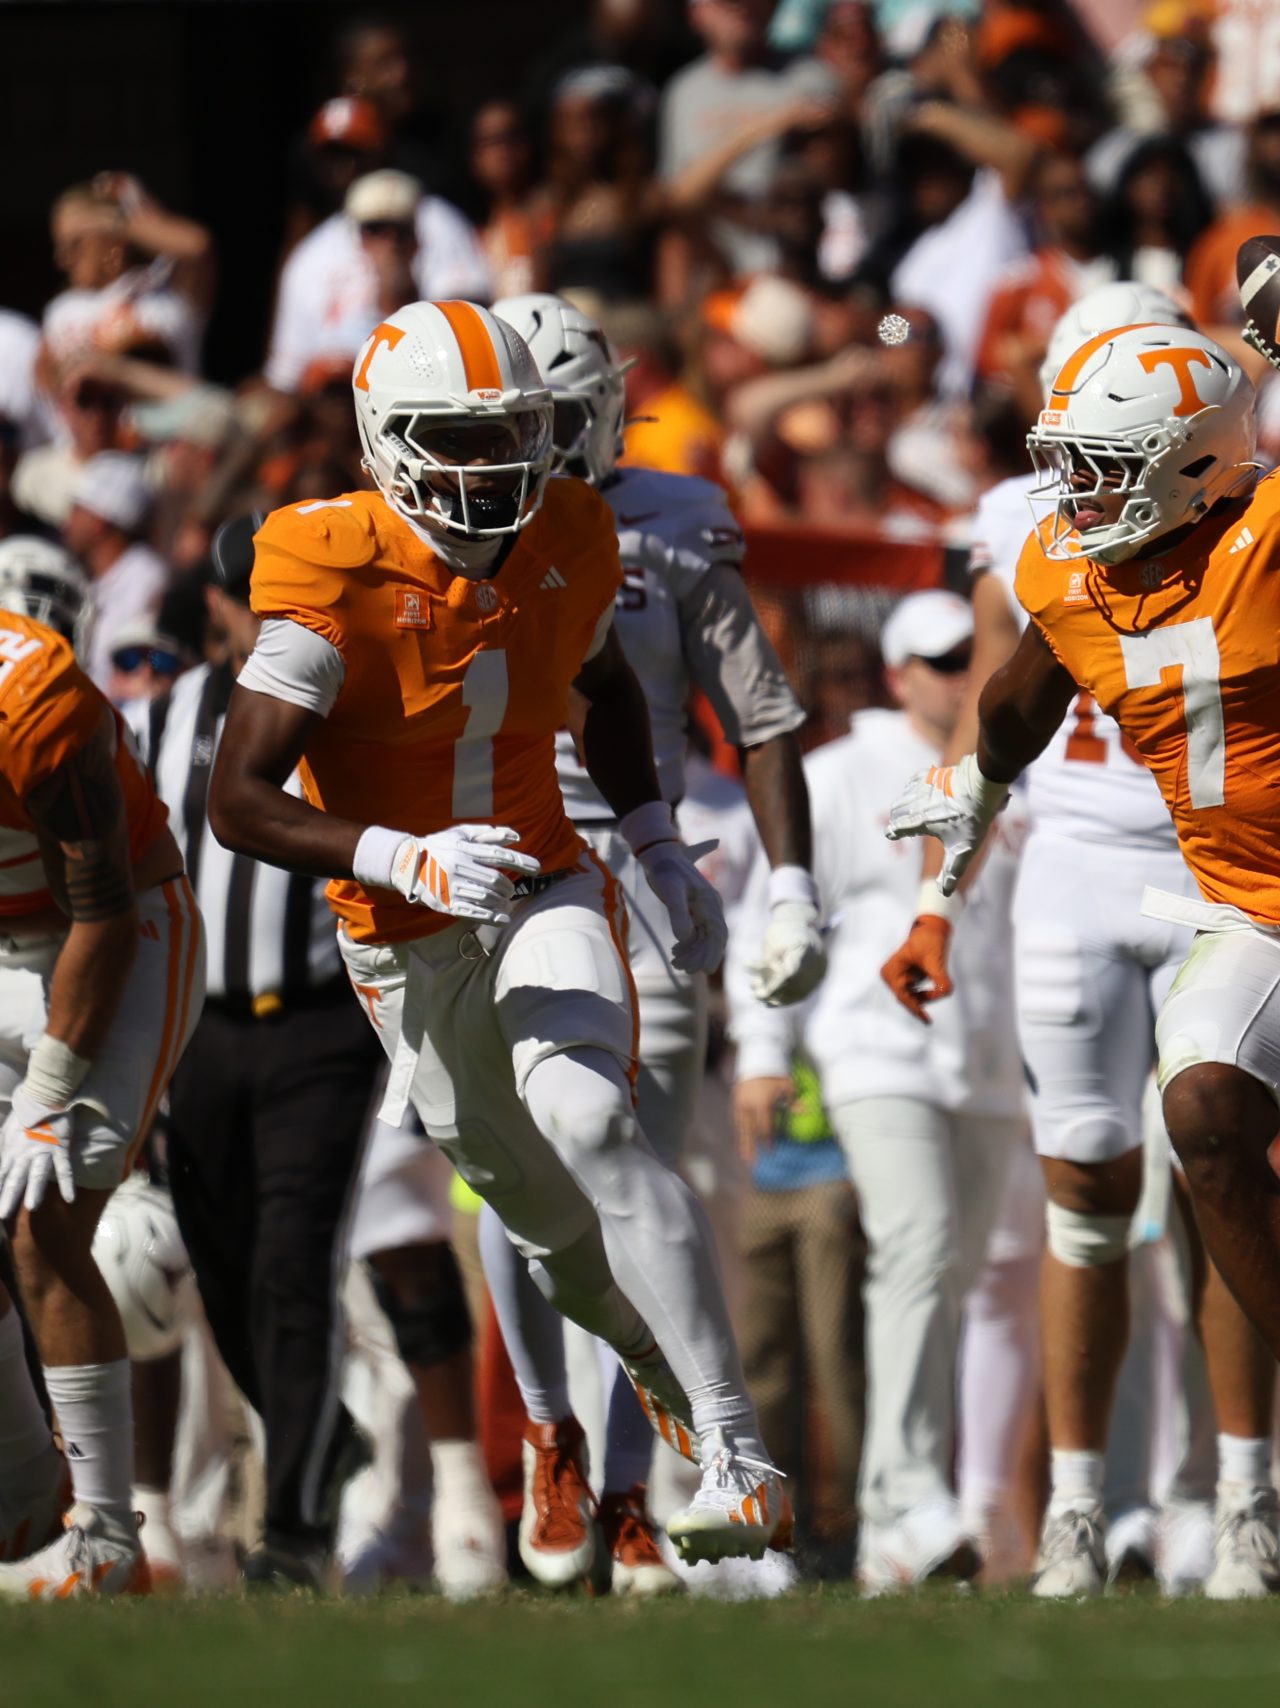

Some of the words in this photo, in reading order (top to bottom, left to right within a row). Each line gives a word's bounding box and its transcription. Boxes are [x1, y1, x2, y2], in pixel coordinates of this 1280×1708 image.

[354, 321, 408, 393] T
[1136, 347, 1212, 417] T
[451, 648, 509, 819] 1
[1119, 616, 1226, 810] 7
